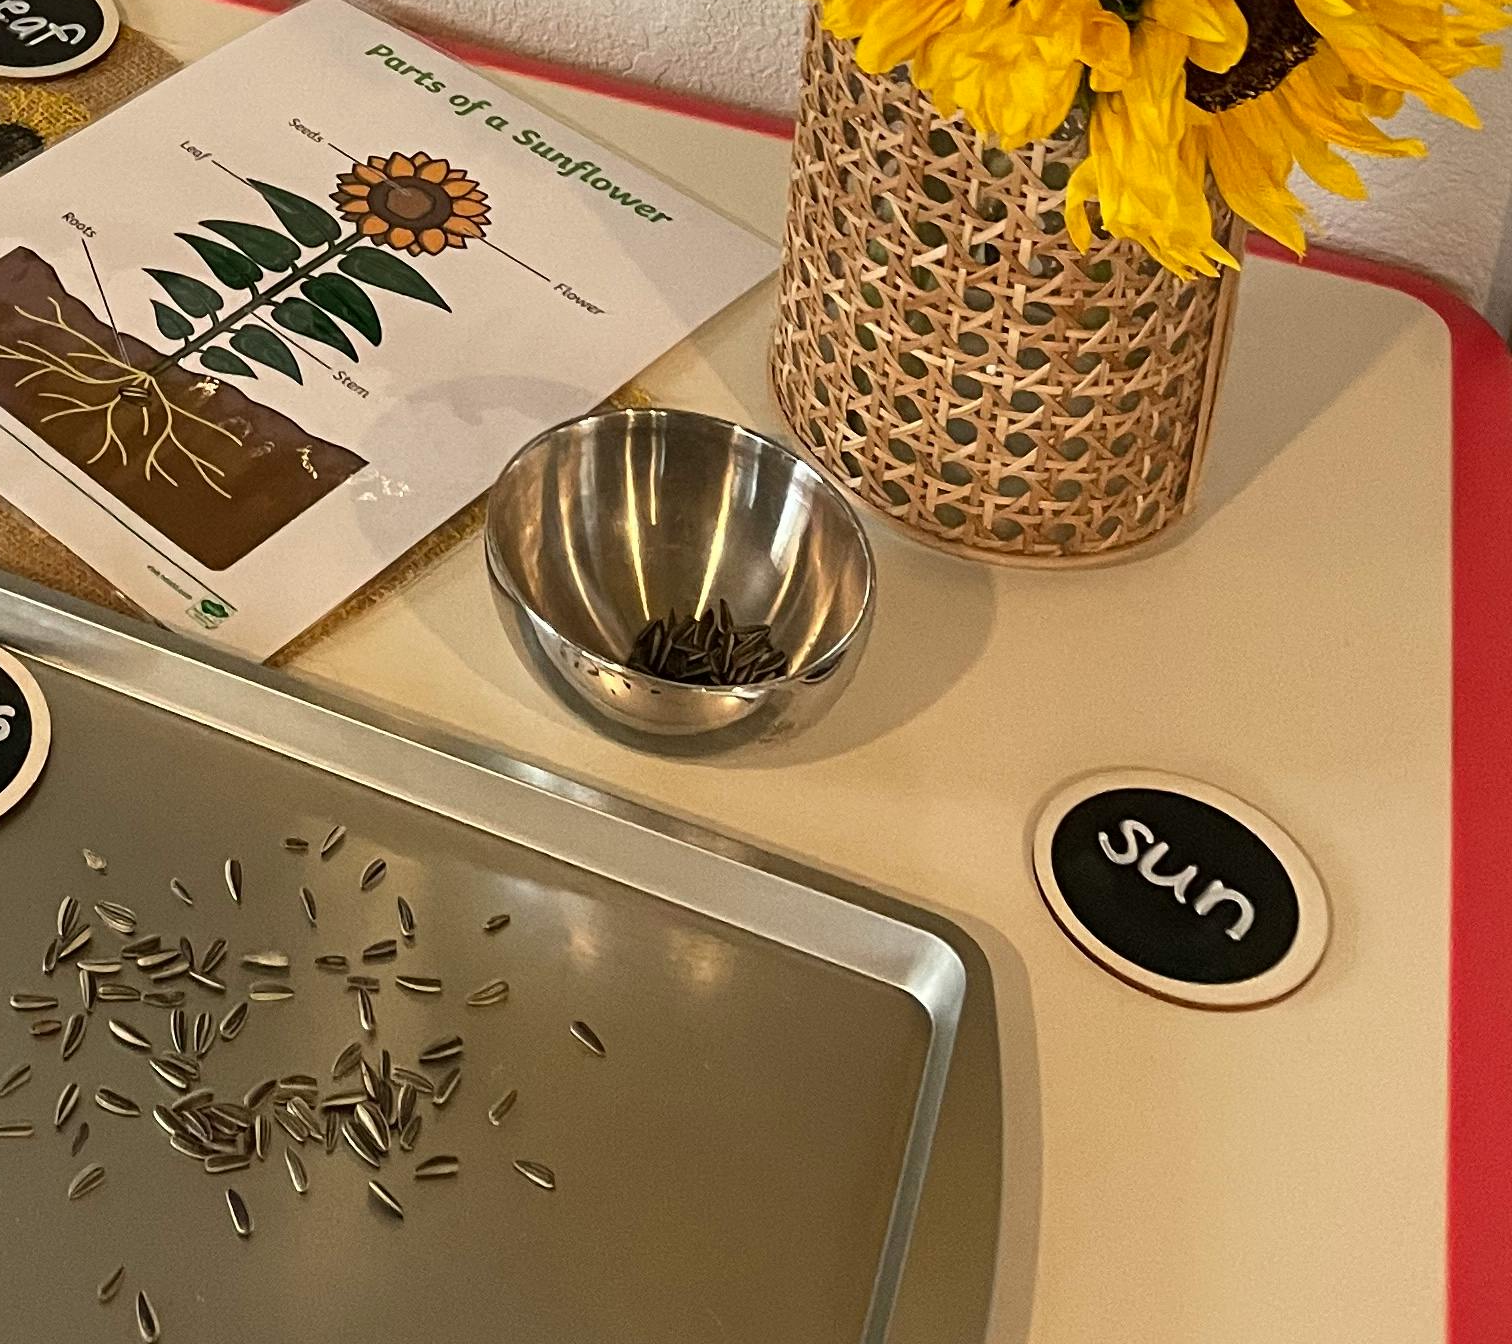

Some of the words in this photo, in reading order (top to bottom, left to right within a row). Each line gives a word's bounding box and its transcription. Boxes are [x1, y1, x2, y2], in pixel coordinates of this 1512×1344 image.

[288, 117, 324, 144] Seeds
[364, 43, 446, 94] Parts
[449, 93, 492, 116] of
[485, 115, 509, 132] a
[512, 128, 673, 224] Sunflower
[179, 139, 212, 161] Leaf
[61, 211, 97, 239] Roots
[332, 369, 370, 399] Stem
[1098, 818, 1255, 941] sun
